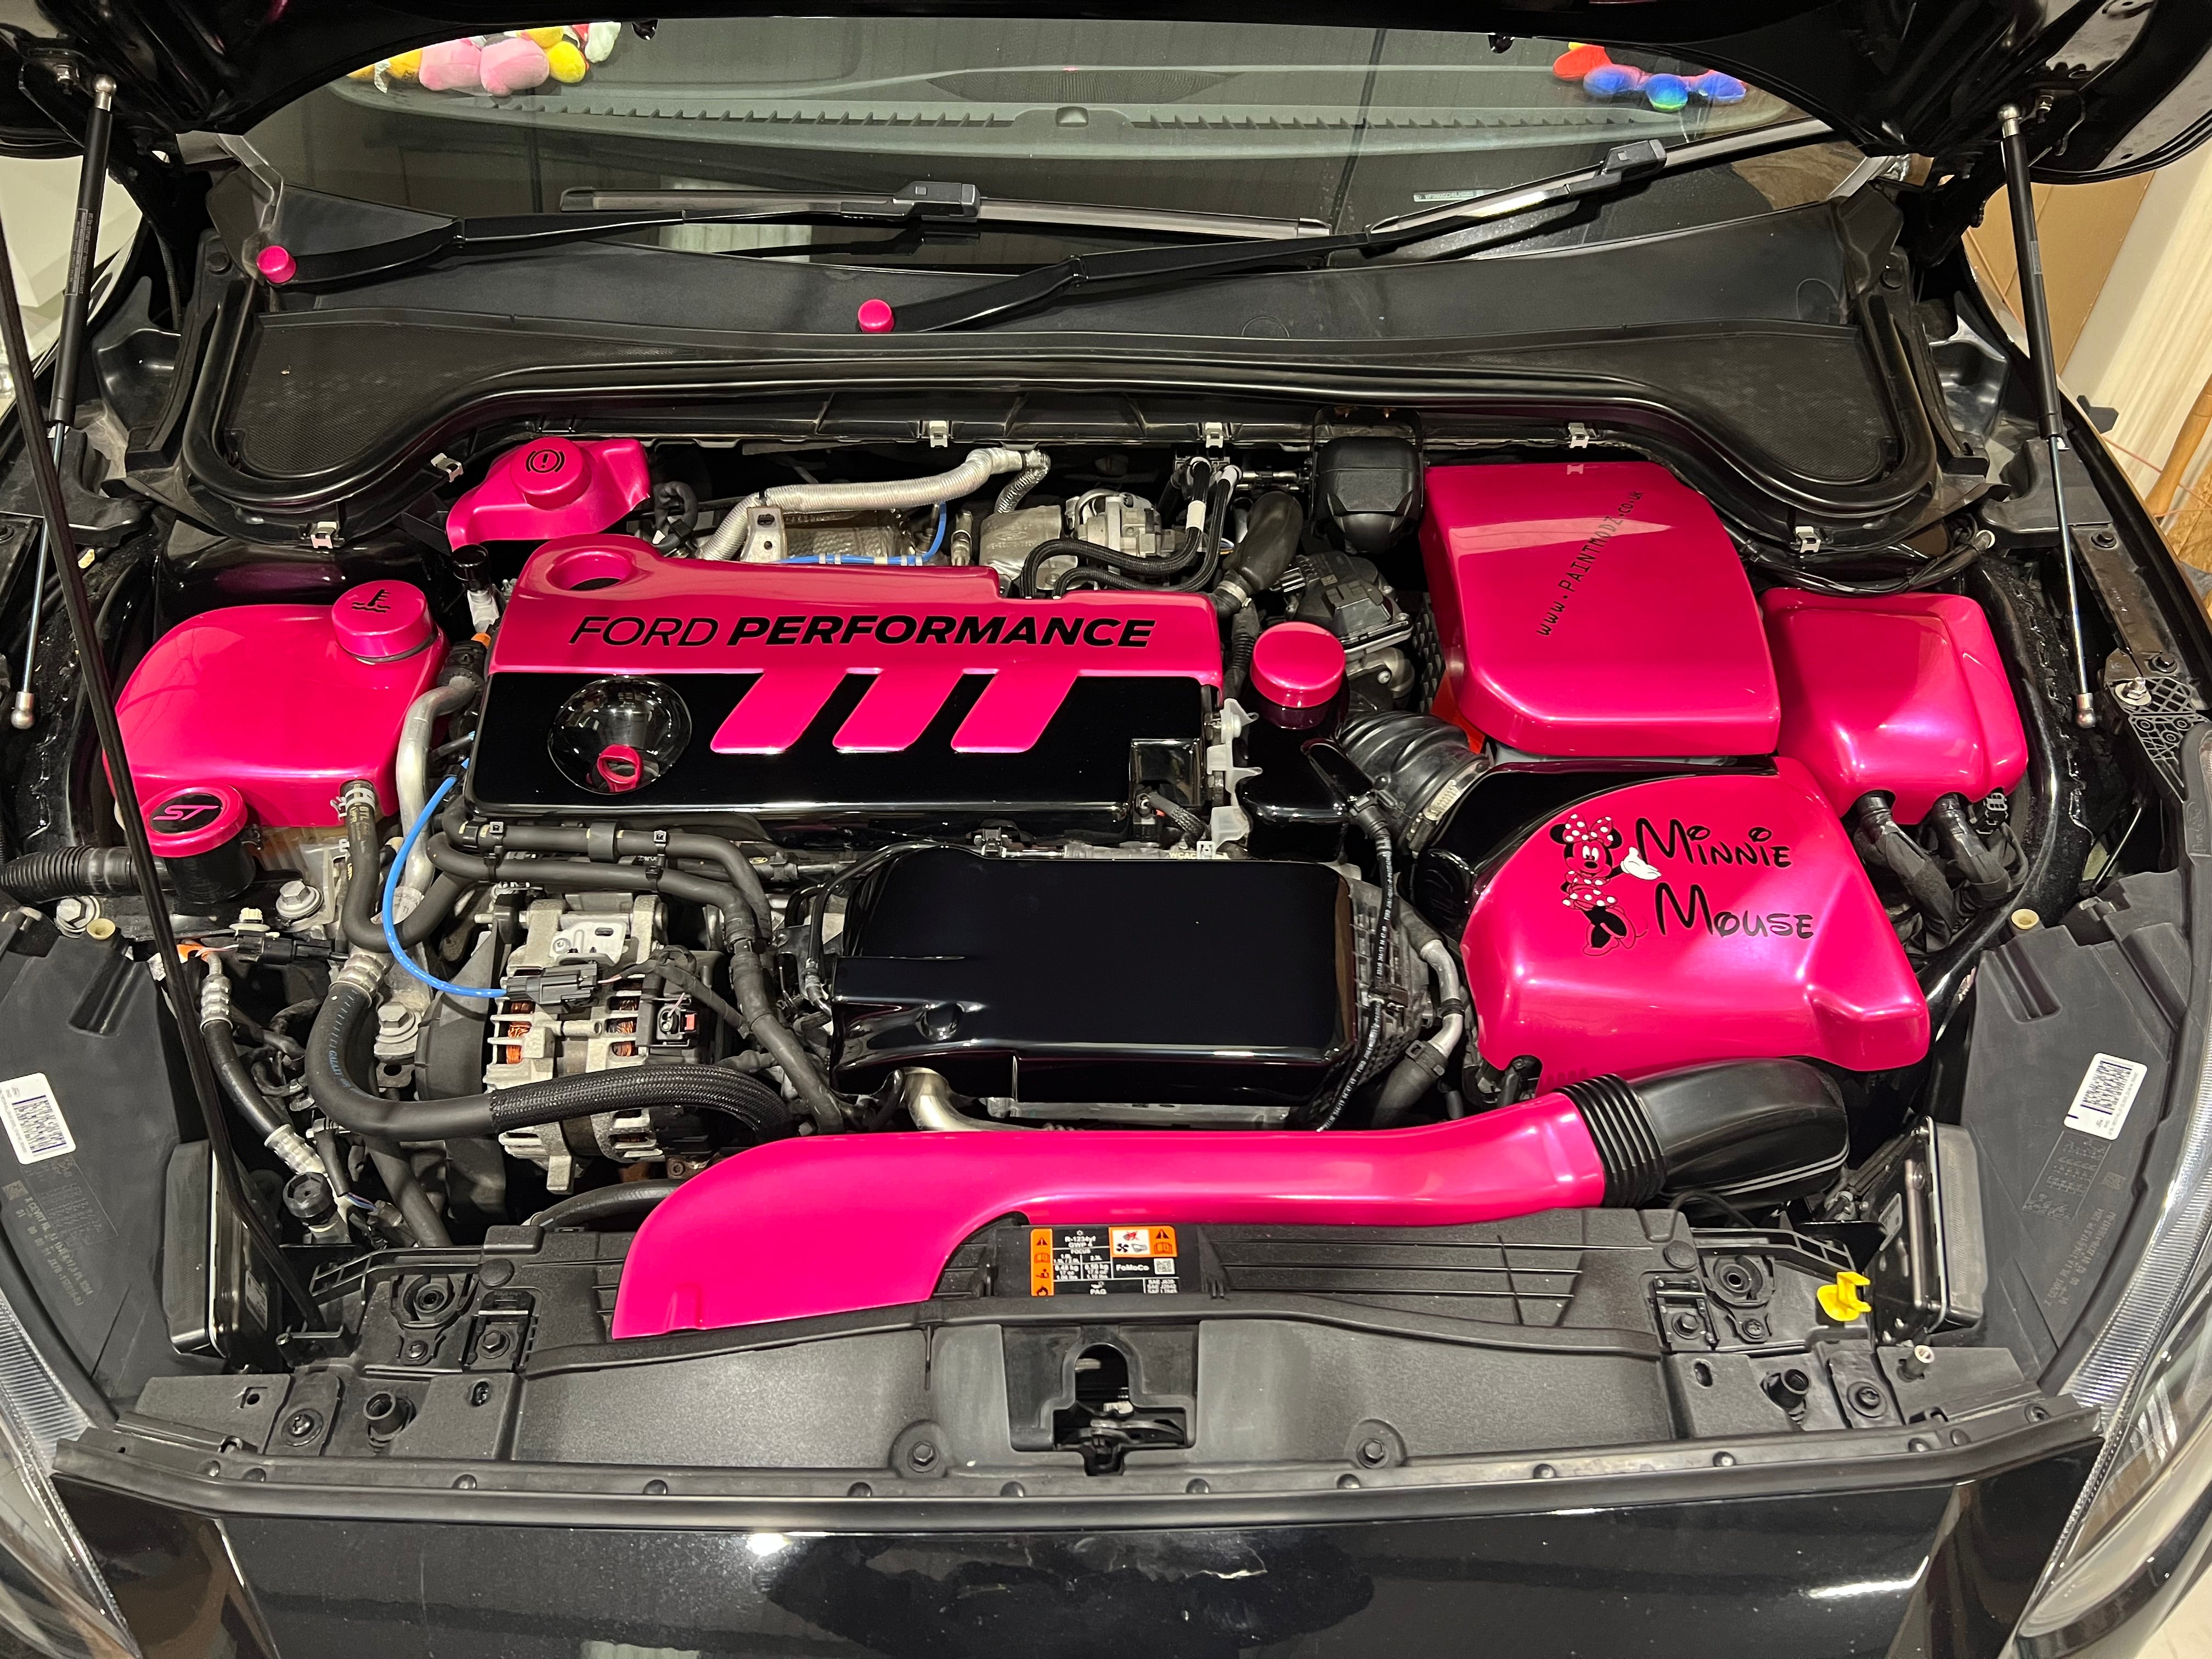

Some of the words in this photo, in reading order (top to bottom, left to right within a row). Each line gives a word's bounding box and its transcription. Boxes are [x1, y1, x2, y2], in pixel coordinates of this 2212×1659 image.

[569, 616, 720, 647] FORD
[726, 614, 1155, 648] PERFORMANCE
[152, 805, 218, 820] ST
